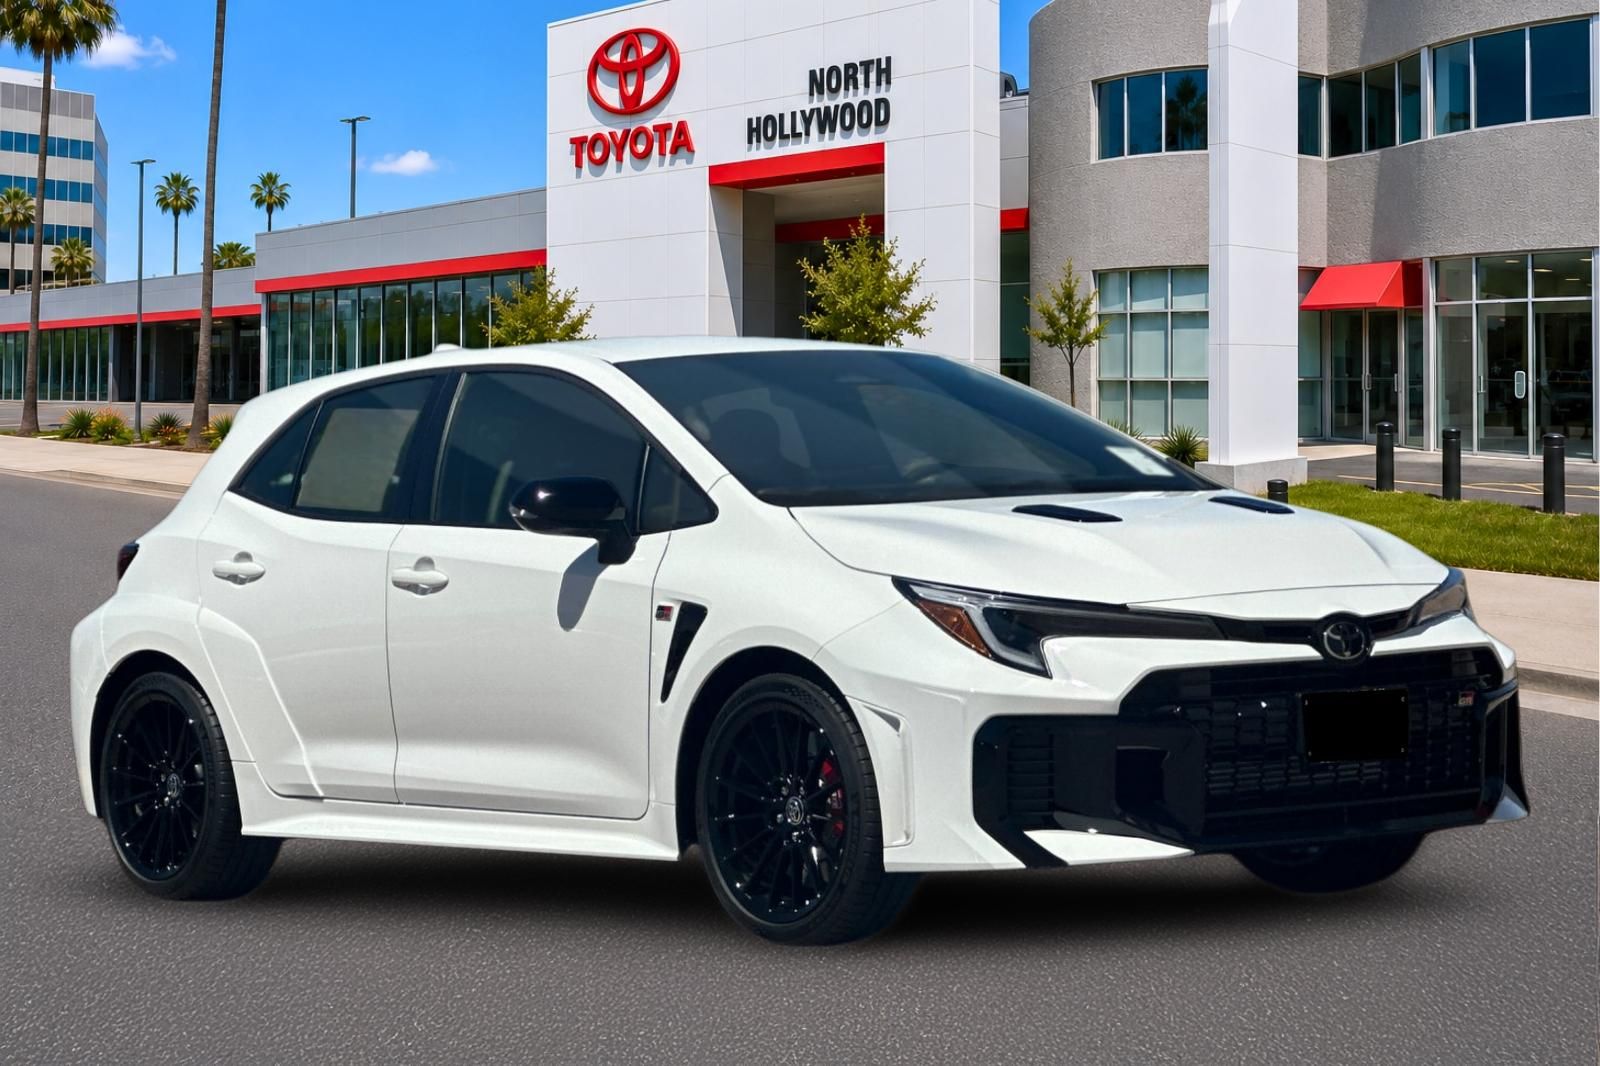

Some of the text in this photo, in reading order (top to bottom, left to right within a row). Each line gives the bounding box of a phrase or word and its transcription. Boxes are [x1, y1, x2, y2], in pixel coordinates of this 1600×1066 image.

[808, 55, 892, 97] NORTH
[569, 120, 695, 169] TOYOTA
[747, 97, 891, 145] HOLLYWOOD
